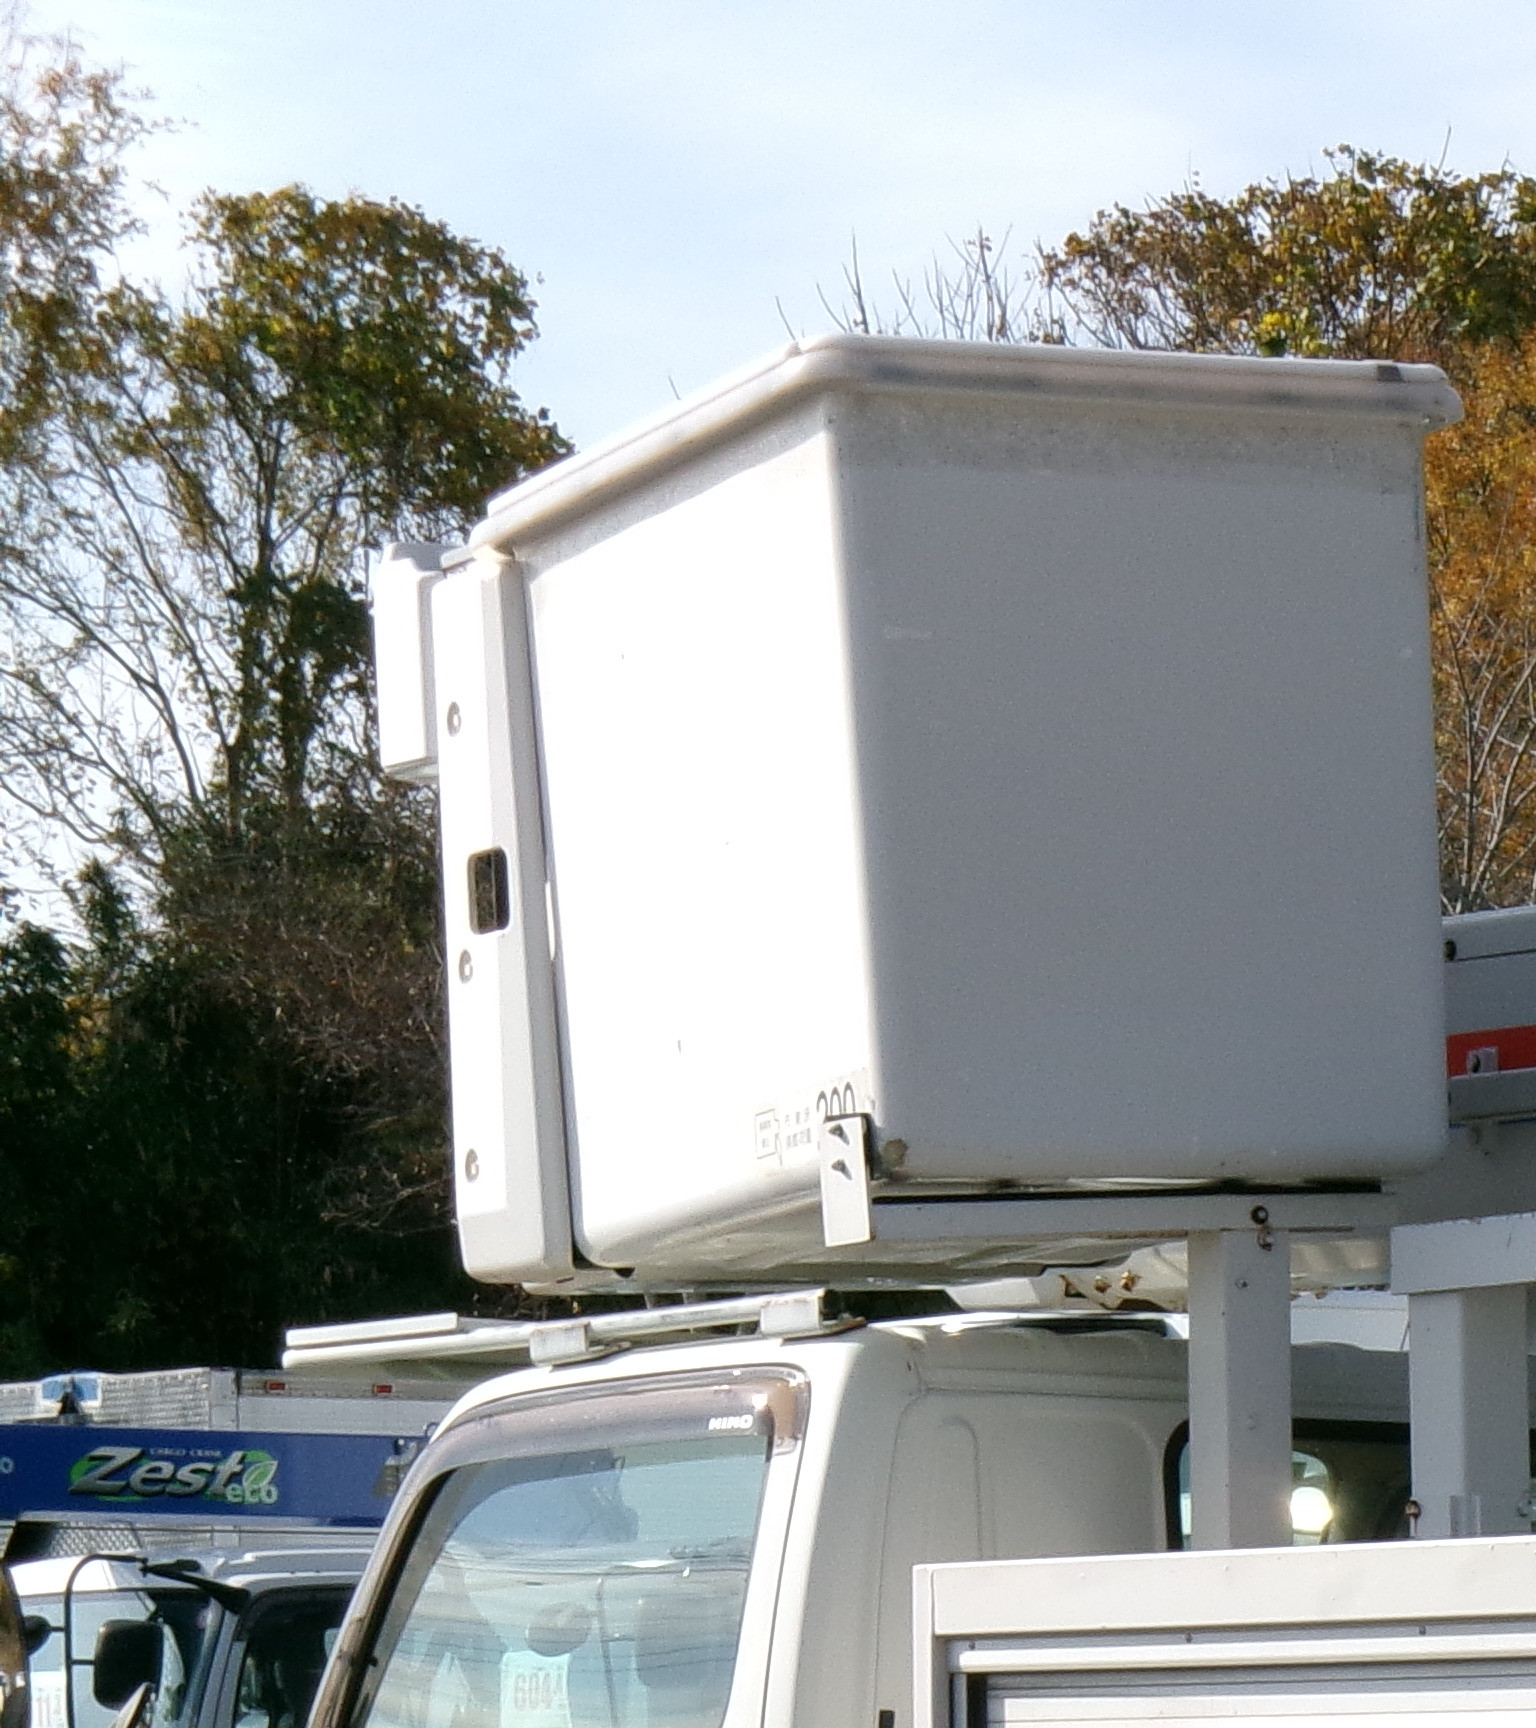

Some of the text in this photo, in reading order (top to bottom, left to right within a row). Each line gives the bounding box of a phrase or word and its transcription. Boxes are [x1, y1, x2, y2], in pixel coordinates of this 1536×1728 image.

[708, 1414, 753, 1430] HINO
[68, 1446, 244, 1497] Zest
[225, 1482, 279, 1504] eco
